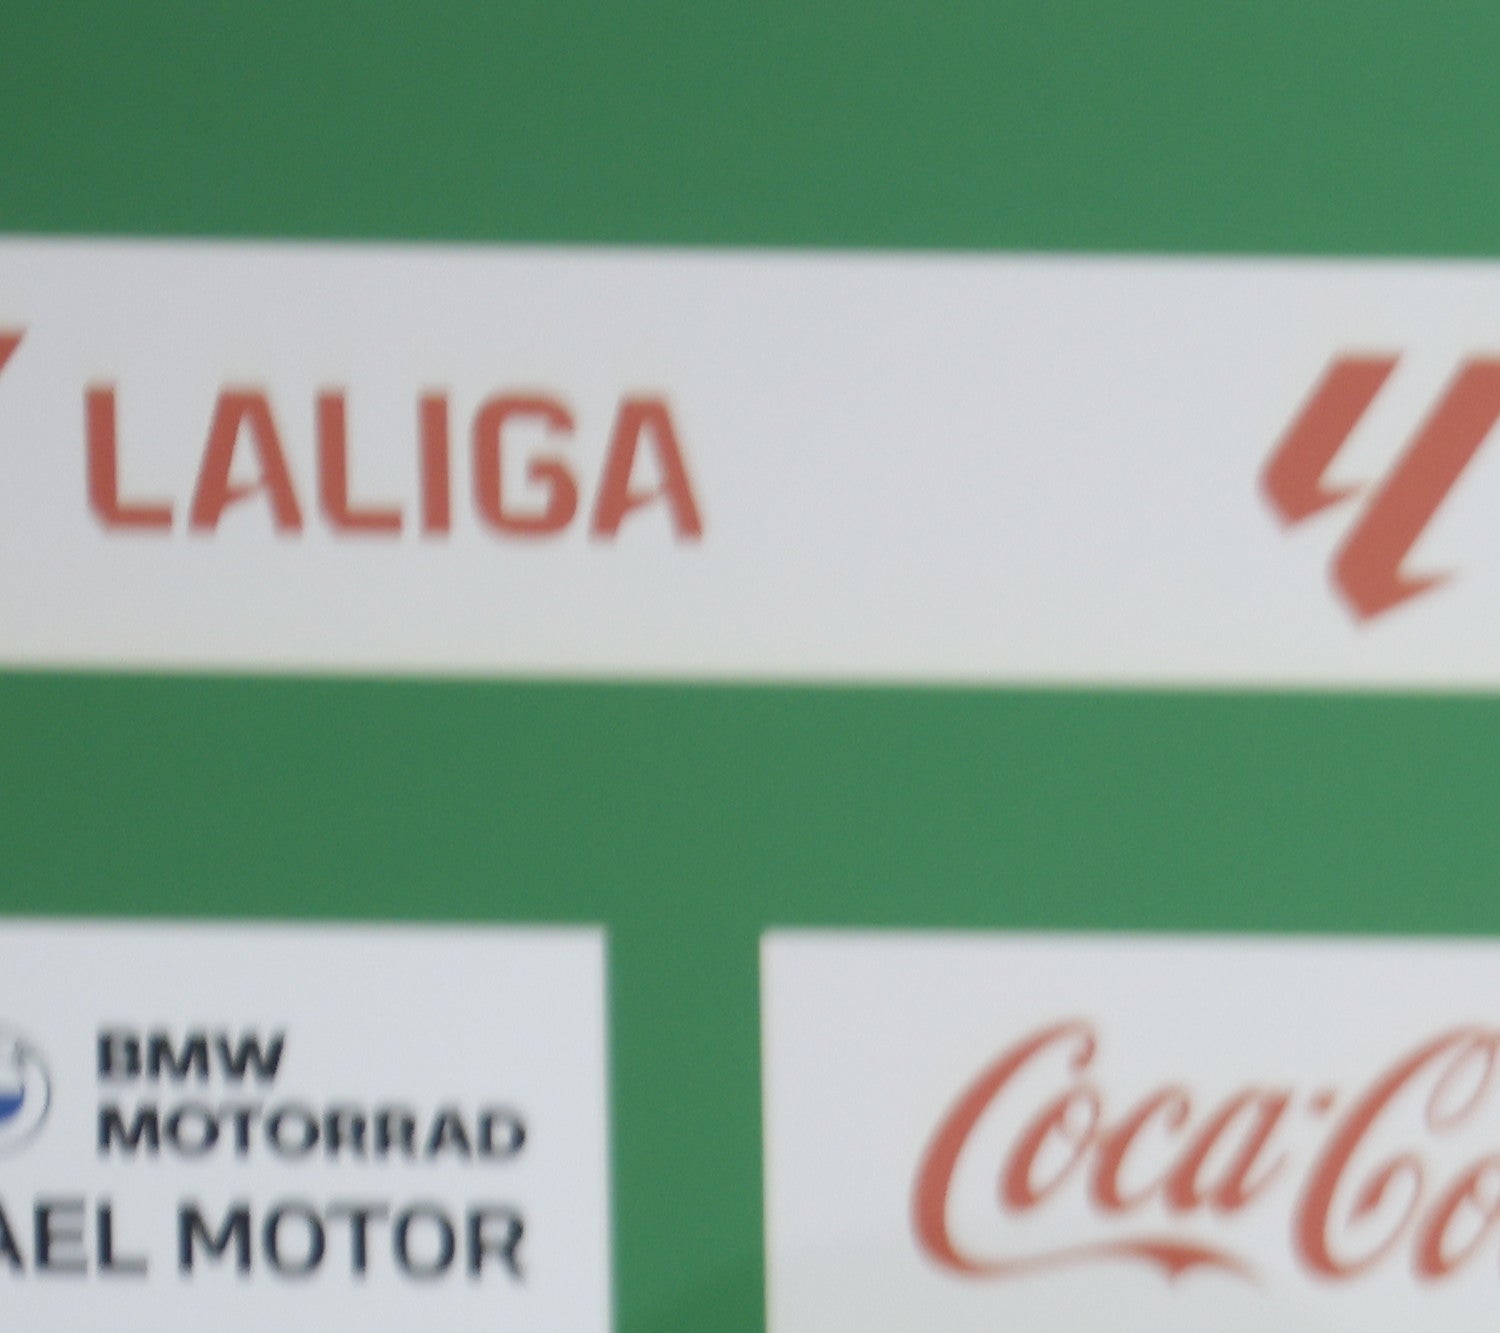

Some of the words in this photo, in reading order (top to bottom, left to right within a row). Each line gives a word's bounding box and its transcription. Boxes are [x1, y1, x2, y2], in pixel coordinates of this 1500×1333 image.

[82, 380, 706, 544] LALIGA
[95, 1028, 286, 1085] BMW
[95, 1100, 529, 1160] MOTORRAD
[175, 1198, 528, 1281] MOTOR
